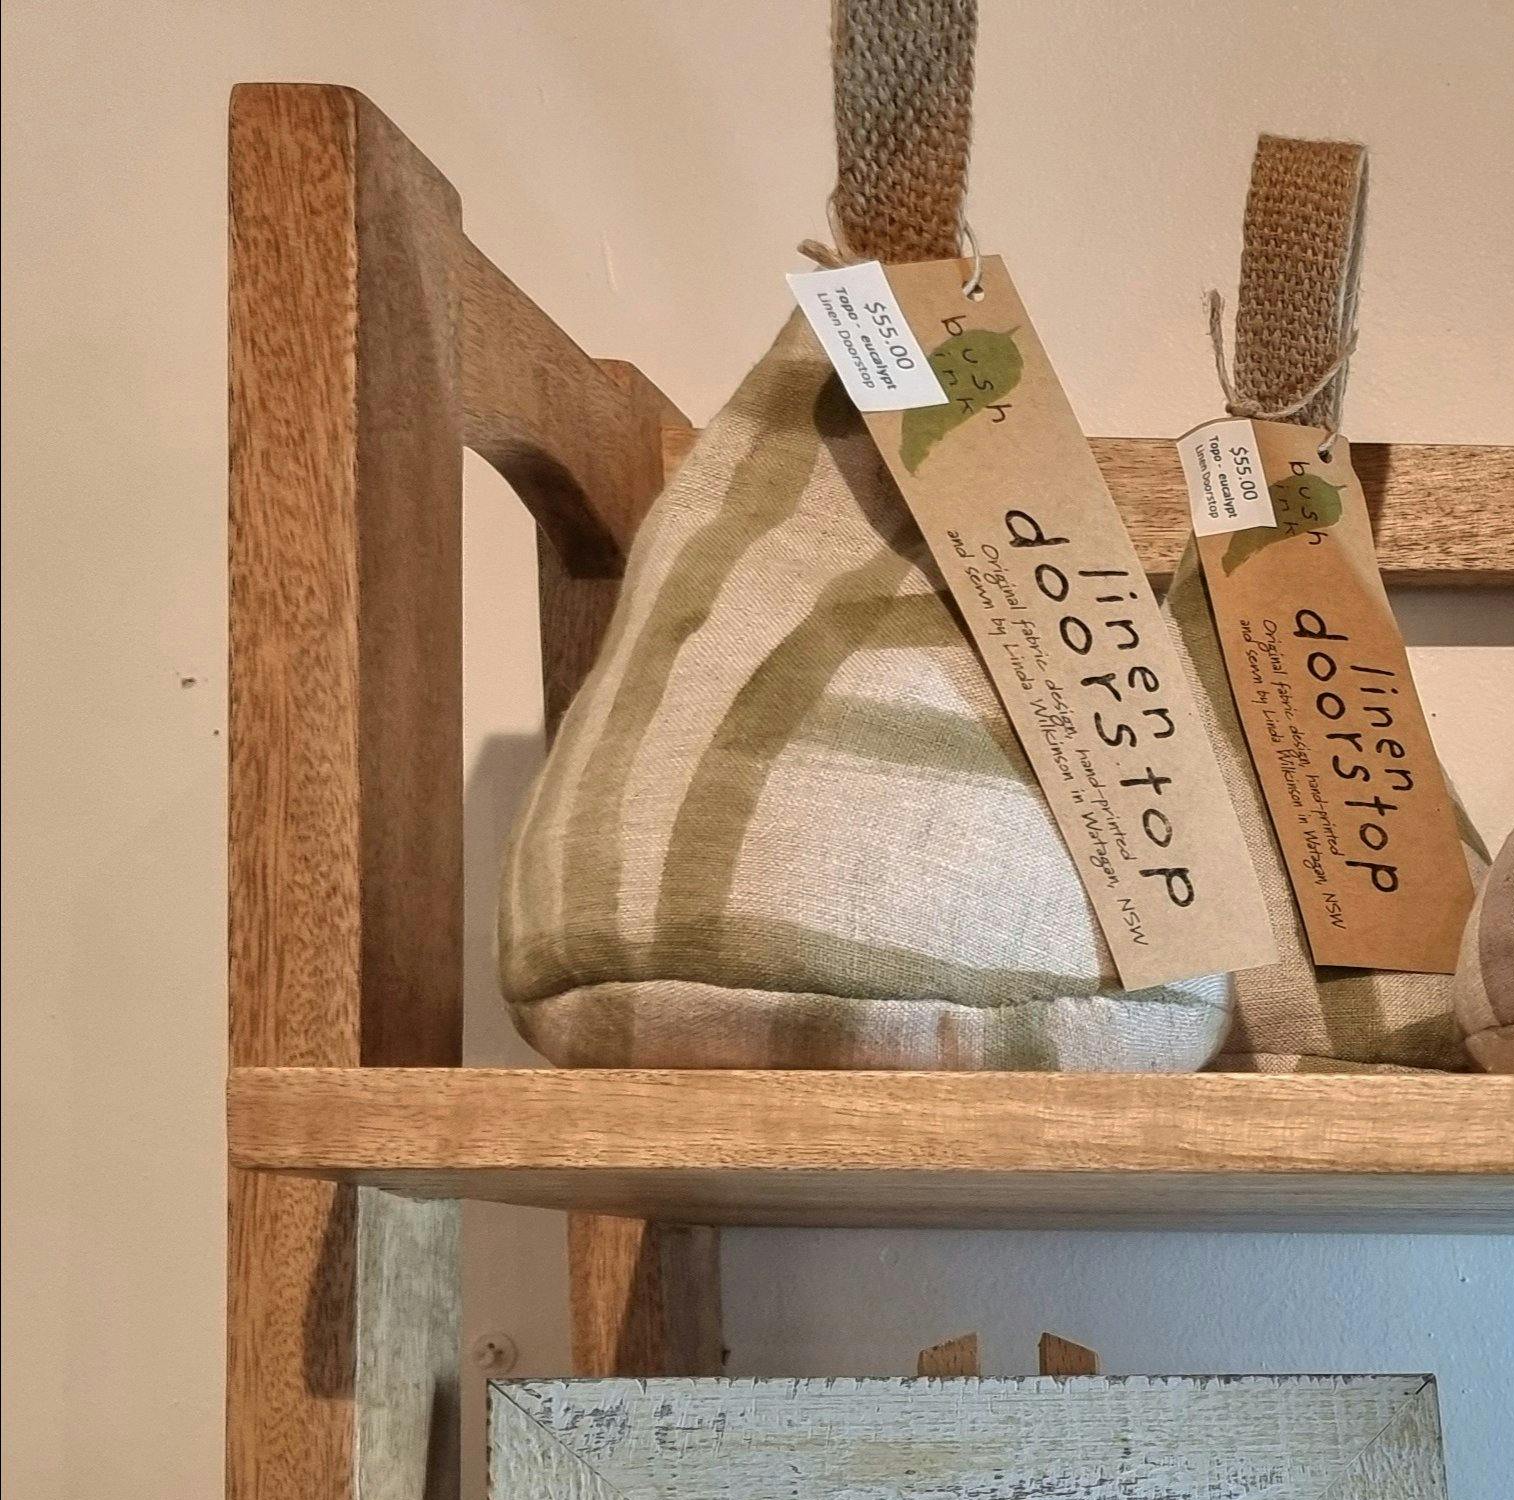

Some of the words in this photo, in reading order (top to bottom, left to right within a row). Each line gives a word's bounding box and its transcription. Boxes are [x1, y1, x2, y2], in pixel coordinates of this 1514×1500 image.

[817, 292, 841, 326] Linen
[838, 330, 875, 389] Doorstop
[836, 286, 858, 320] Topo
[861, 334, 897, 390] eucalypt
[864, 302, 915, 370] $55.00
[941, 315, 1012, 423] bush
[935, 353, 973, 414] ink
[1195, 444, 1207, 469] Linen
[1202, 471, 1219, 519] Doorstop
[1209, 435, 1222, 463] Topo
[1218, 473, 1238, 519] eucalypt
[1229, 446, 1259, 501] $55.00
[1289, 461, 1328, 545] bush
[1275, 484, 1299, 536] ink
[1078, 570, 1175, 738] linen
[1240, 620, 1256, 643] and
[1249, 650, 1263, 684] sewn
[1258, 620, 1287, 675] Original
[981, 544, 1027, 610] Original
[1011, 619, 1048, 673] fabric
[1075, 749, 1138, 861] hand-printed
[1005, 510, 1194, 907] doorstop
[1251, 690, 1269, 704] by
[1262, 710, 1284, 743] Linda
[1271, 681, 1291, 720] fabric
[1350, 665, 1414, 791] linen
[947, 529, 975, 558] and
[965, 567, 994, 609] sewn
[988, 617, 1007, 636] by
[1003, 643, 1033, 690] Linda
[1030, 699, 1074, 781] Wilkinson
[1071, 789, 1086, 804] in
[1117, 898, 1149, 946] NSW
[1293, 609, 1398, 892] doorstop
[1276, 749, 1302, 807] Wilkinson
[1298, 813, 1309, 824] in
[1306, 774, 1345, 857] hand-printed
[1322, 892, 1346, 930] NSW
